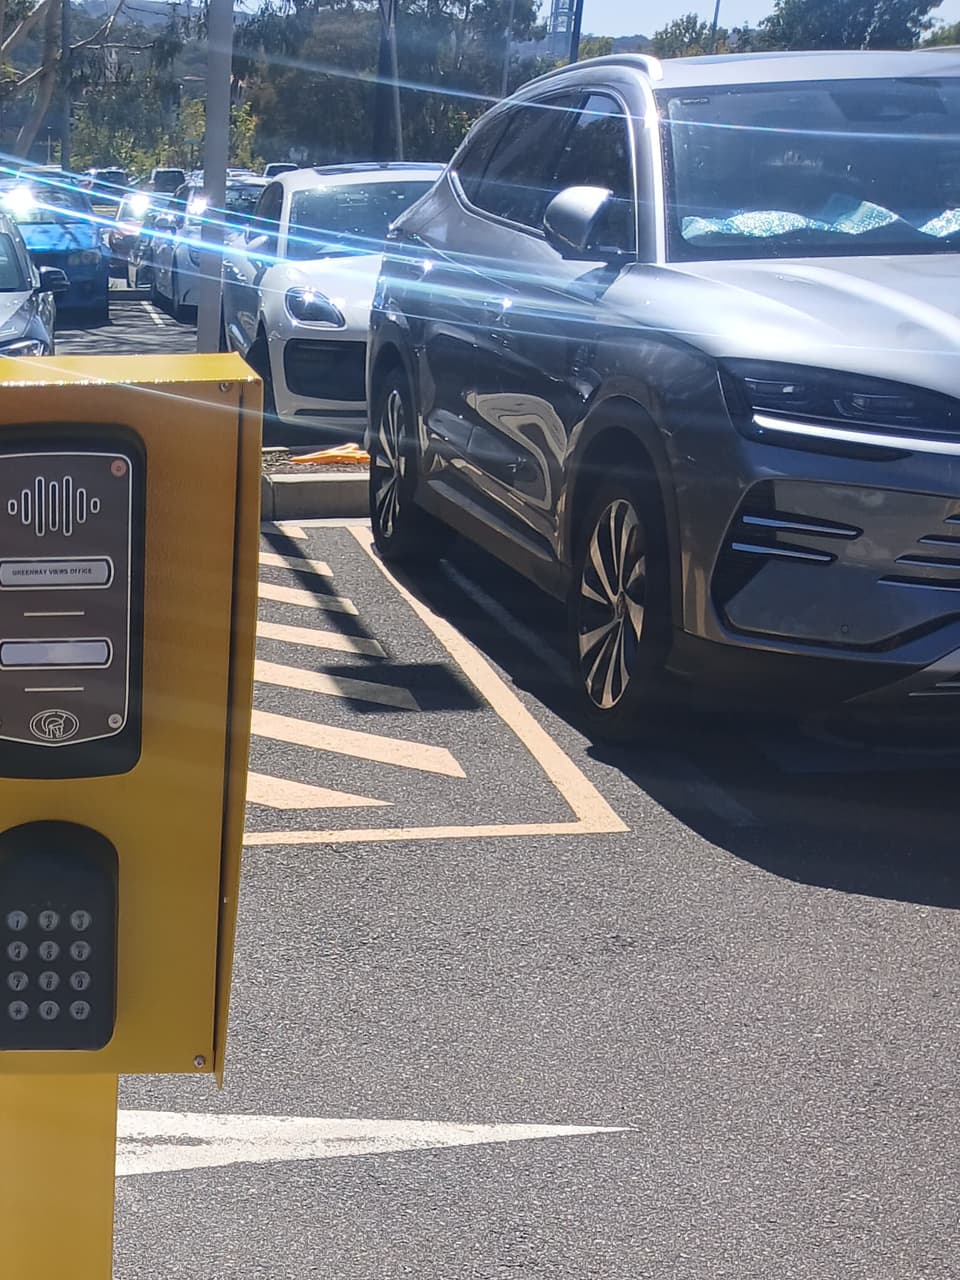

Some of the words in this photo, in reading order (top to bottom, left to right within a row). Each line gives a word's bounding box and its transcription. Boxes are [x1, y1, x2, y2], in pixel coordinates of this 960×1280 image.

[12, 568, 48, 576] GREENWAY
[48, 567, 68, 575] VIEWS
[69, 567, 92, 575] OFFICE
